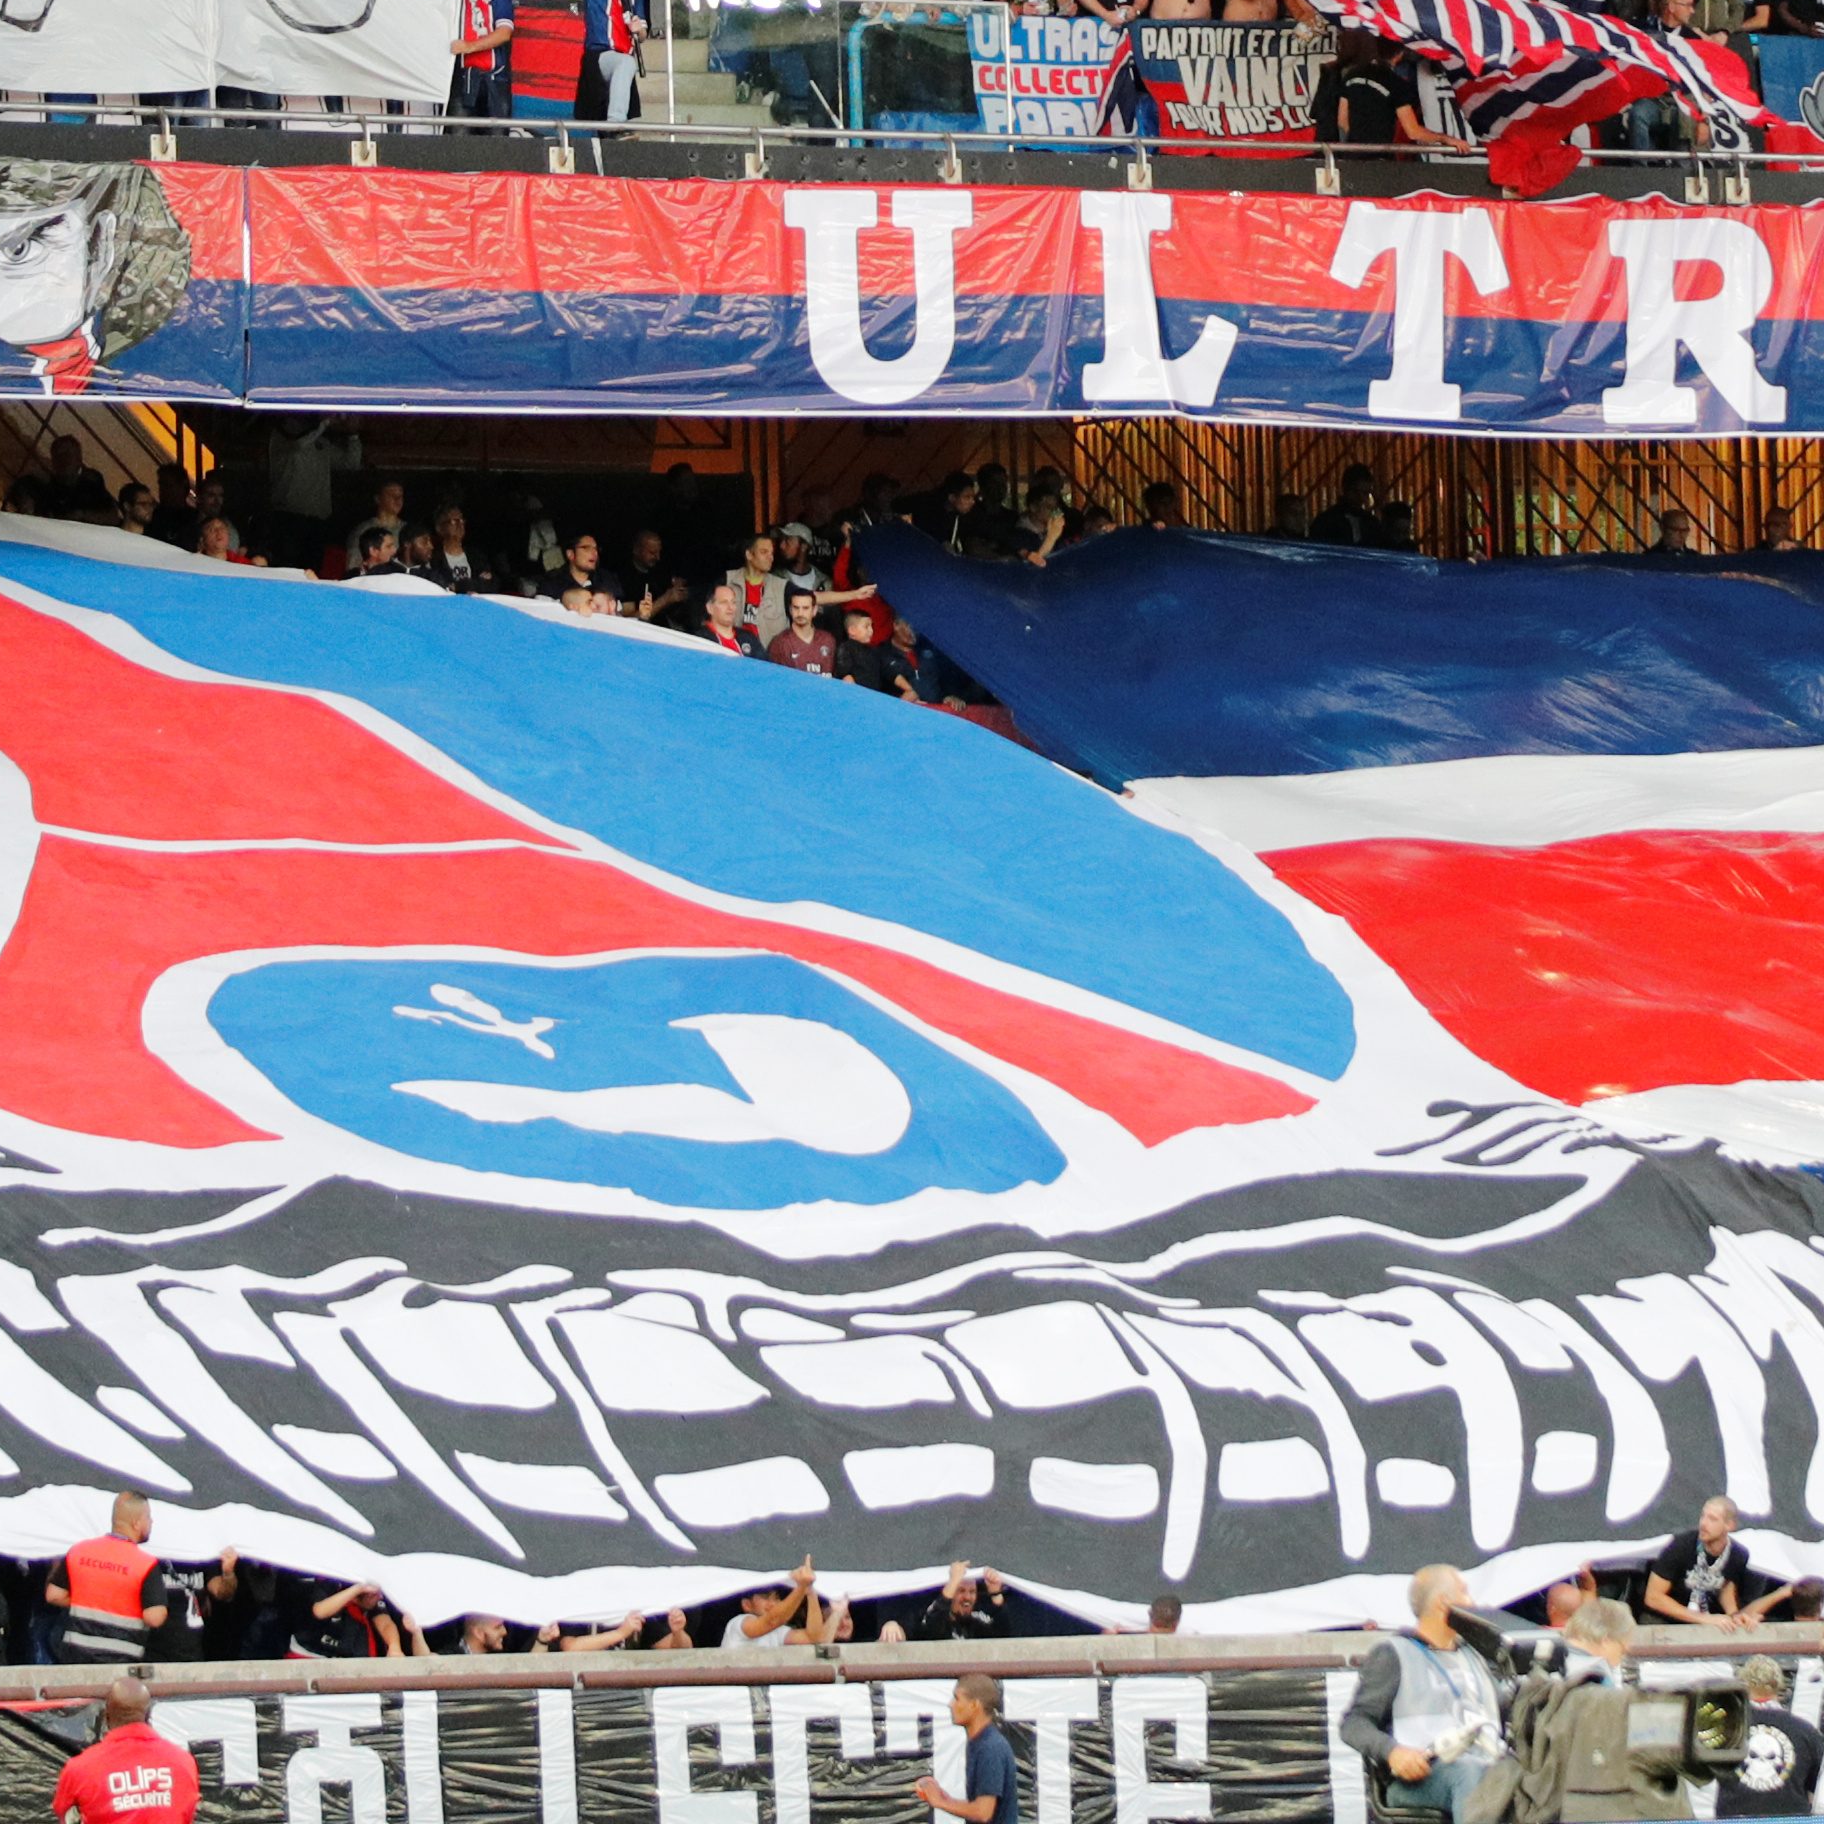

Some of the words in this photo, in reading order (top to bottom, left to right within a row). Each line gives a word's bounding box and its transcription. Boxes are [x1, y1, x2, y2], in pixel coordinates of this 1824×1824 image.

[972, 15, 1119, 63] ULTRAS
[1227, 105, 1278, 135] NOS
[107, 1766, 174, 1795] OLIPS
